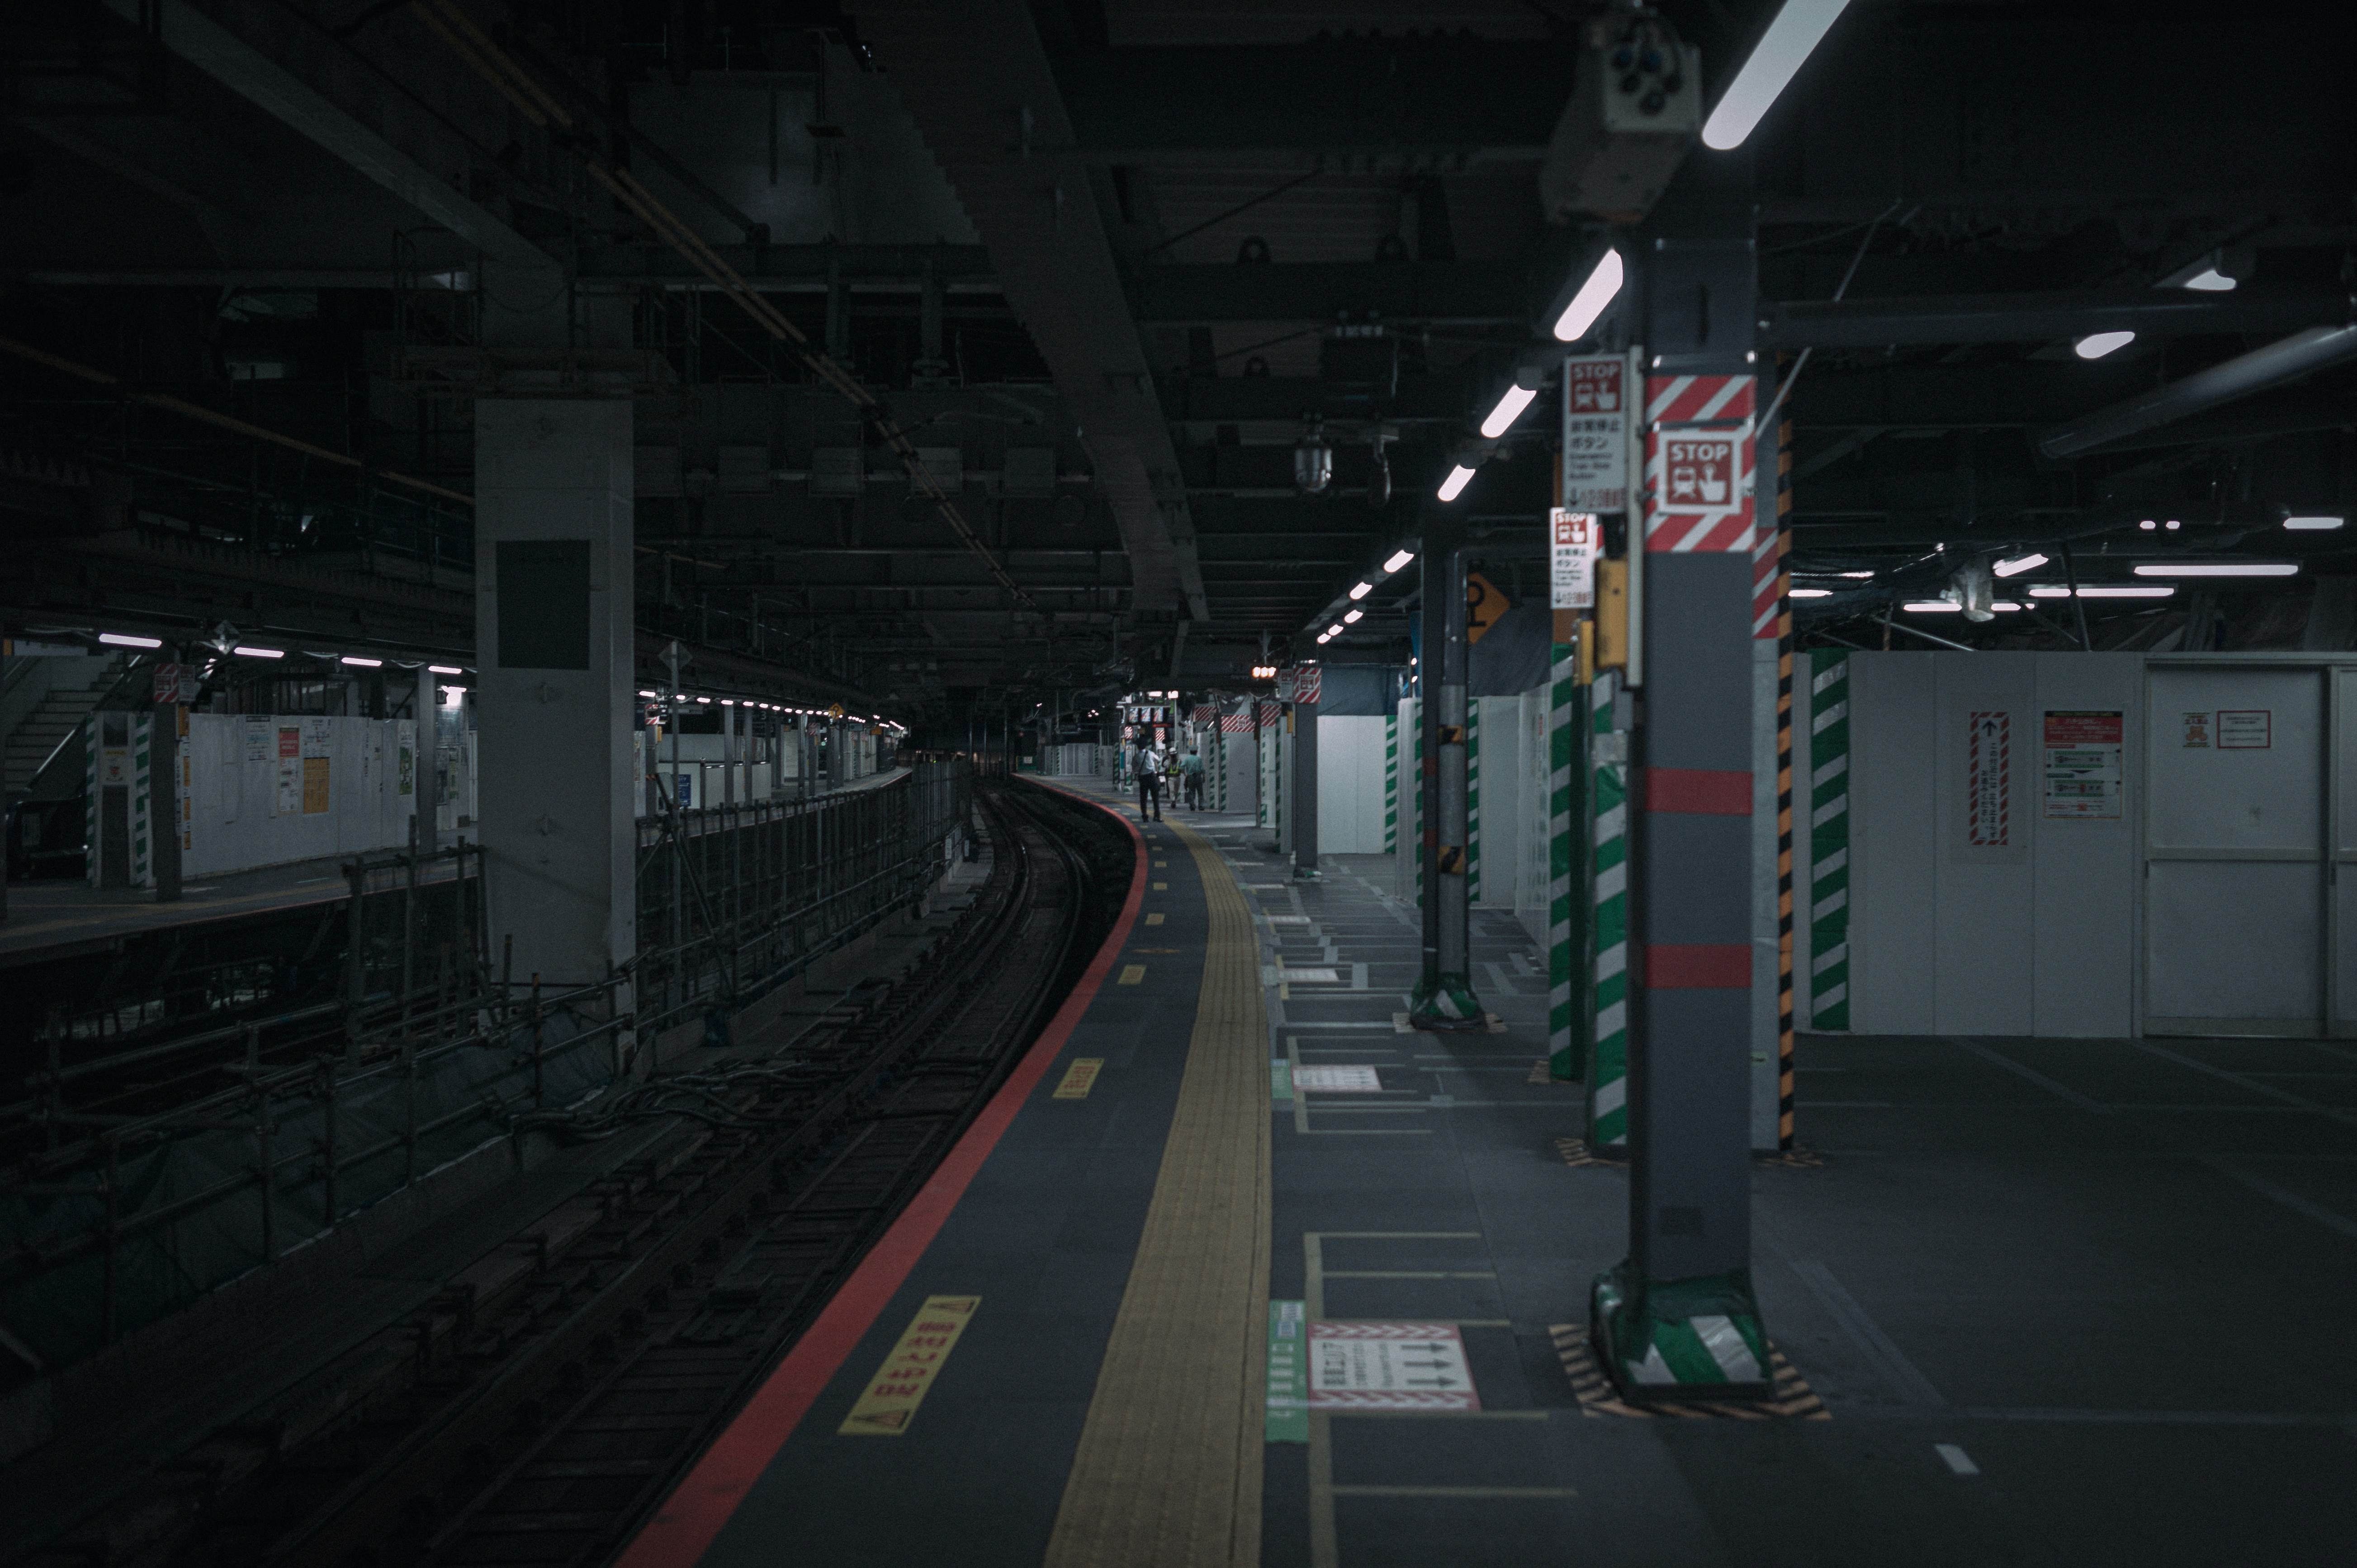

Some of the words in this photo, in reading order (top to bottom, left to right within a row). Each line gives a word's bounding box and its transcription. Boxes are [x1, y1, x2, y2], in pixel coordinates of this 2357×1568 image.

[1573, 364, 1619, 380] STOP
[1571, 436, 1609, 449] ボタン
[1671, 443, 1729, 462] STOP
[1557, 513, 1586, 523] STOP
